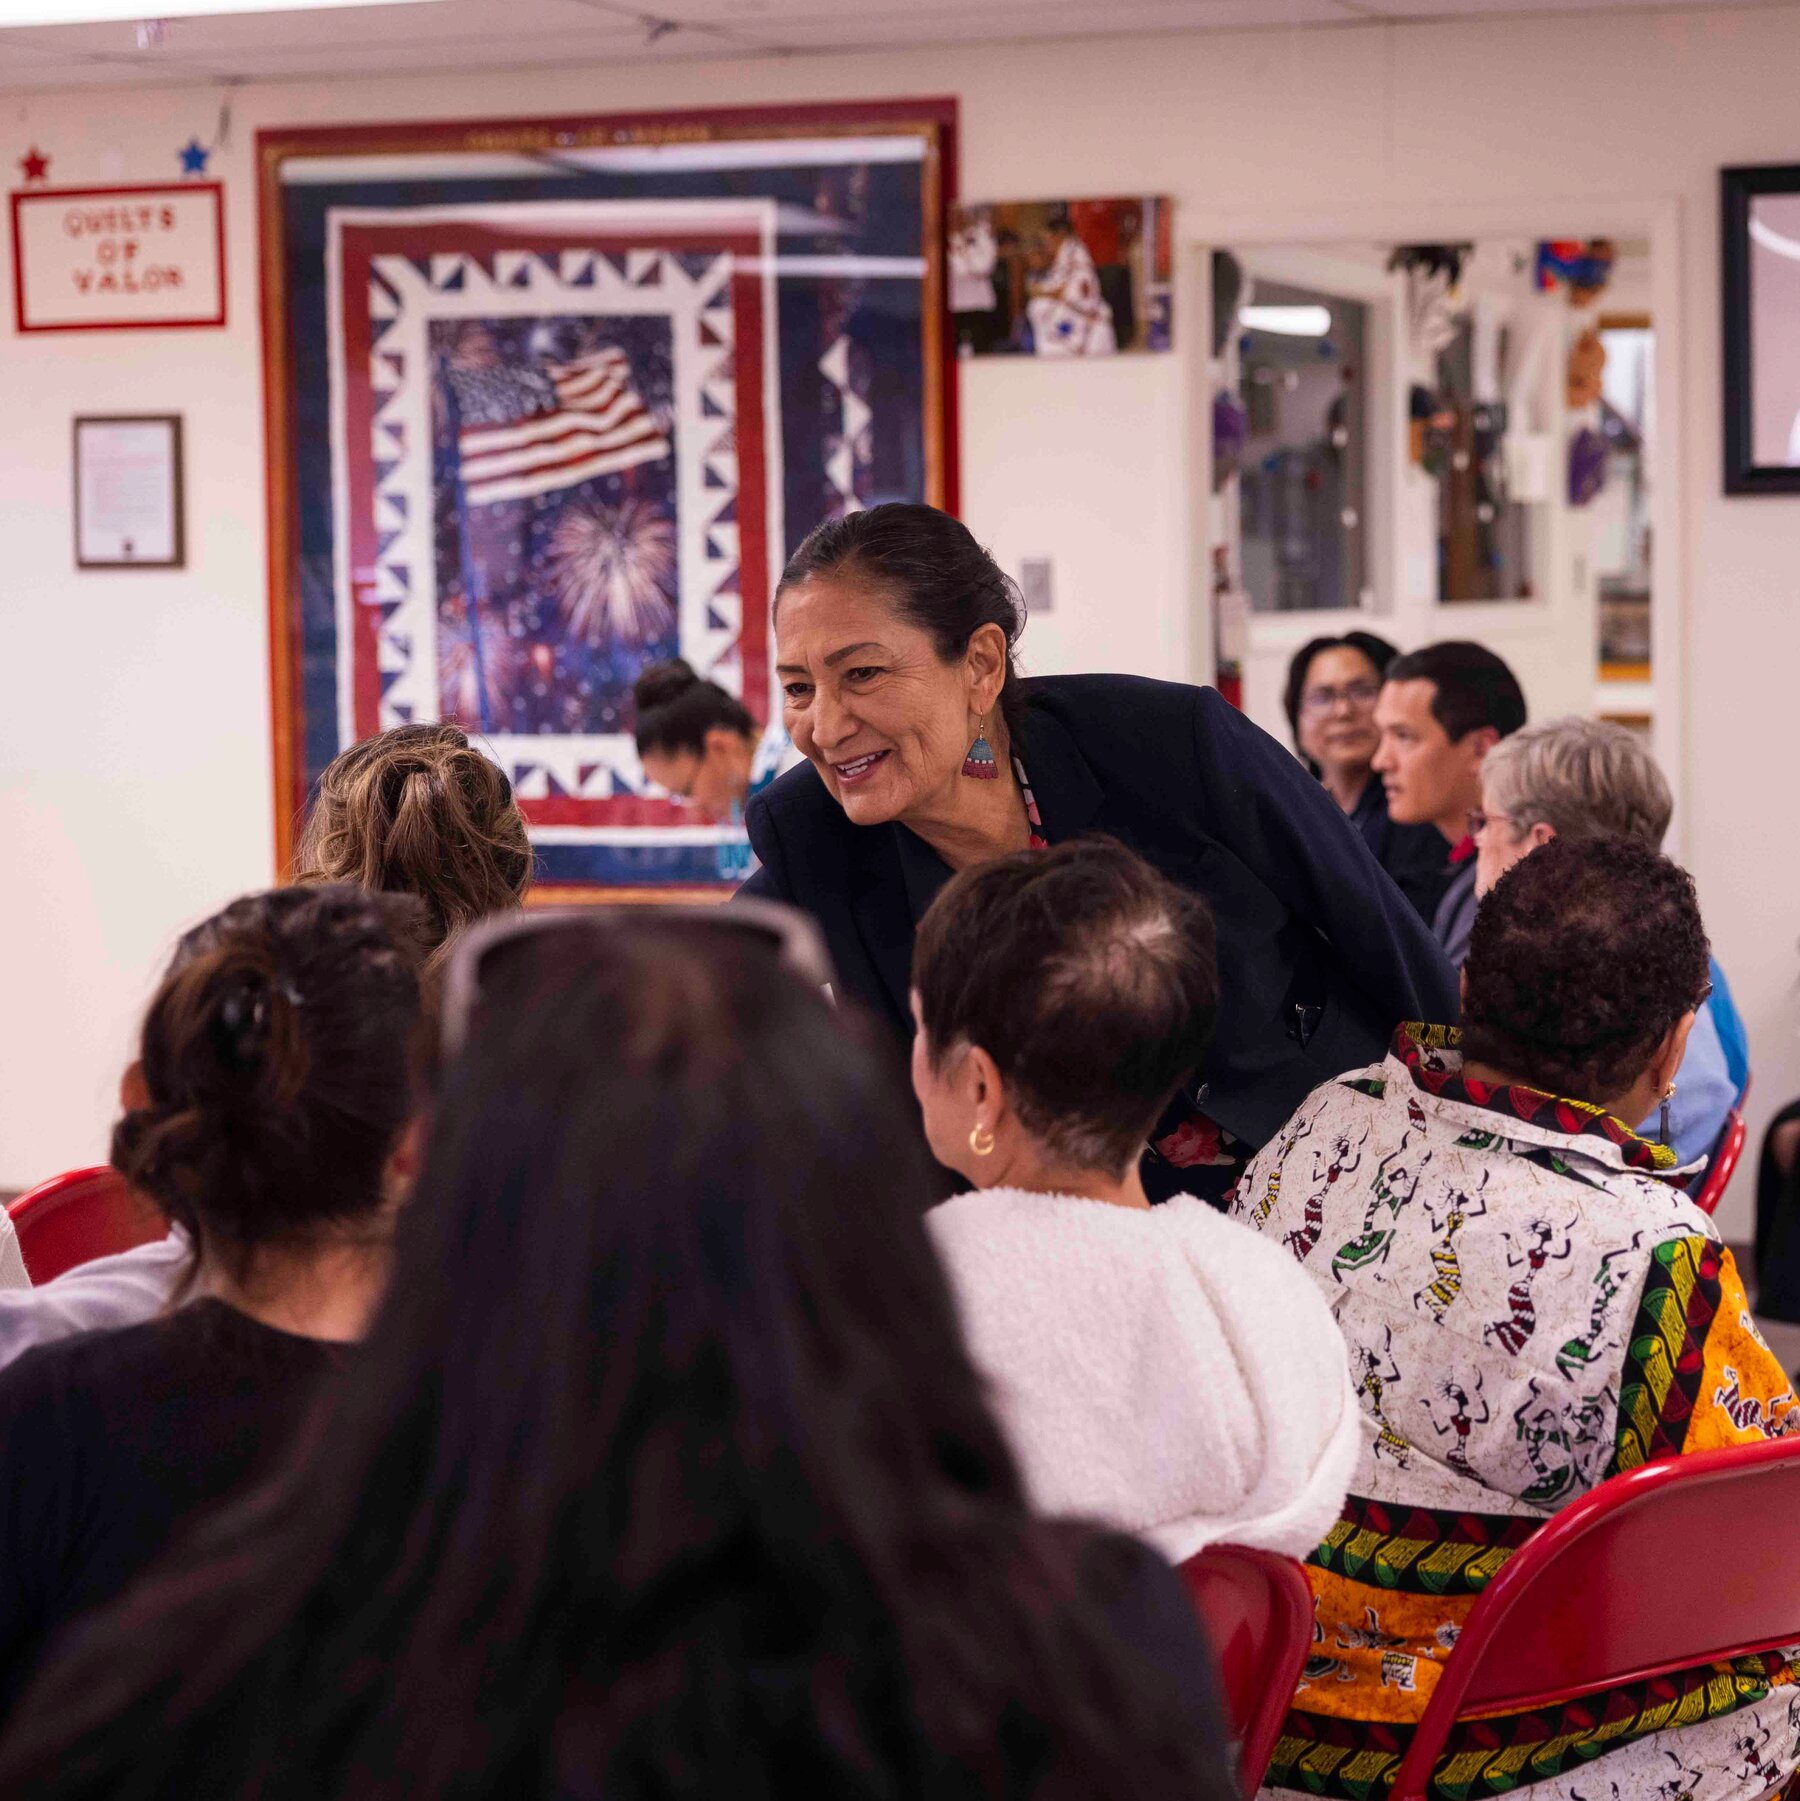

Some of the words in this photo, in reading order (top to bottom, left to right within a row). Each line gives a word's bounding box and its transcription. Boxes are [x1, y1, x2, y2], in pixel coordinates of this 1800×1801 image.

[63, 205, 174, 239] QUILTS
[96, 239, 138, 265] OF
[72, 264, 183, 294] VALOR
